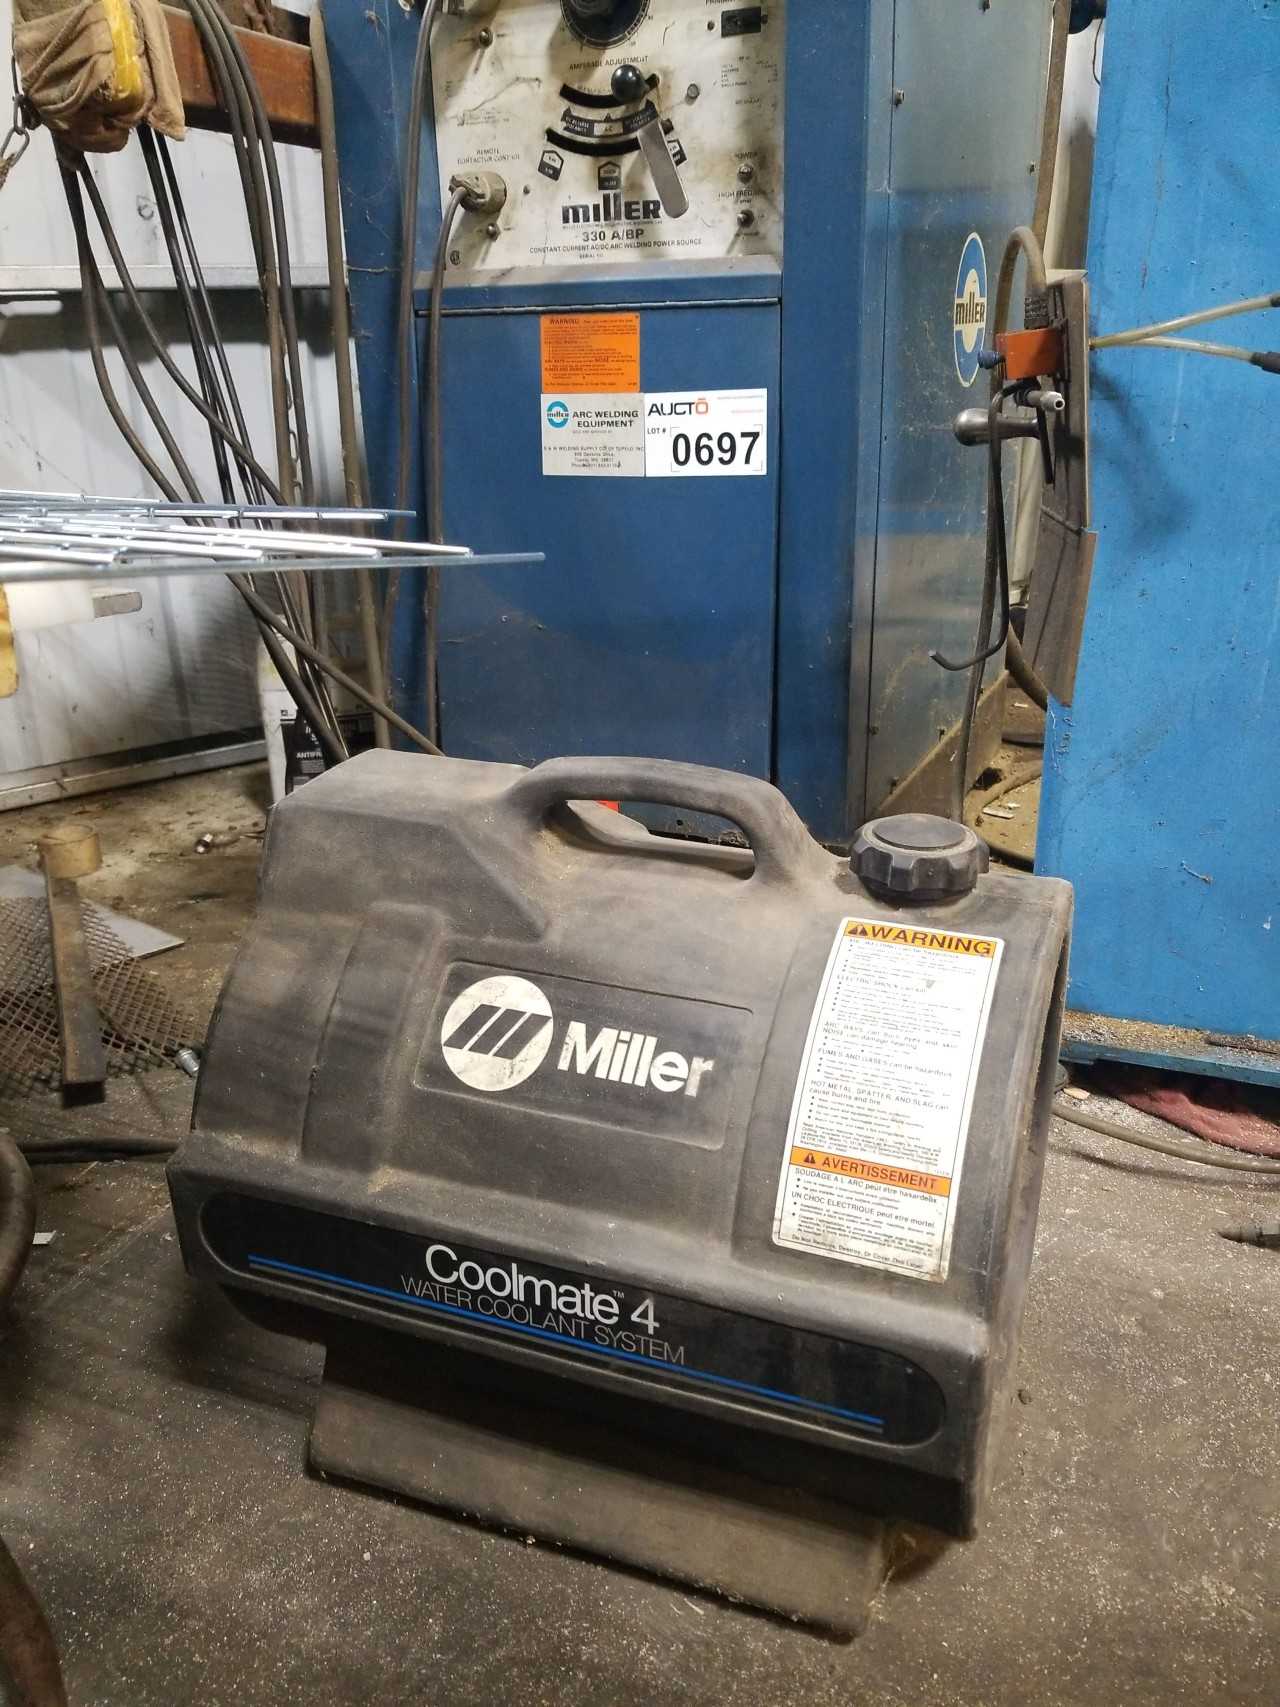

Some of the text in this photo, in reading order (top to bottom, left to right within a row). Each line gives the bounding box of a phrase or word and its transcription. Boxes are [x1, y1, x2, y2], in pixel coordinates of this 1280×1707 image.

[582, 229, 645, 242] 330 A/BP
[624, 240, 652, 250] WELDING
[653, 239, 676, 249] POWER
[676, 238, 702, 247] SOURCE
[572, 410, 639, 419] ARC WELDING
[577, 420, 634, 428] EQUIPMENT
[647, 427, 660, 435] LOT
[672, 431, 760, 467] 0697
[870, 925, 992, 956] WARNING
[557, 1020, 715, 1098] Miller
[895, 1095, 912, 1104] AND
[794, 1168, 833, 1182] SOUDAGE
[865, 1183, 882, 1194] peut
[822, 1156, 939, 1190] AVERTISSEMENT
[791, 1191, 803, 1199] UN
[803, 1193, 826, 1205] CHOC
[827, 1198, 875, 1216] ELECTRIQUE
[876, 1210, 894, 1220] peut
[401, 1275, 686, 1366] WATER COOLANT SYSTEM
[630, 1296, 660, 1336] 4
